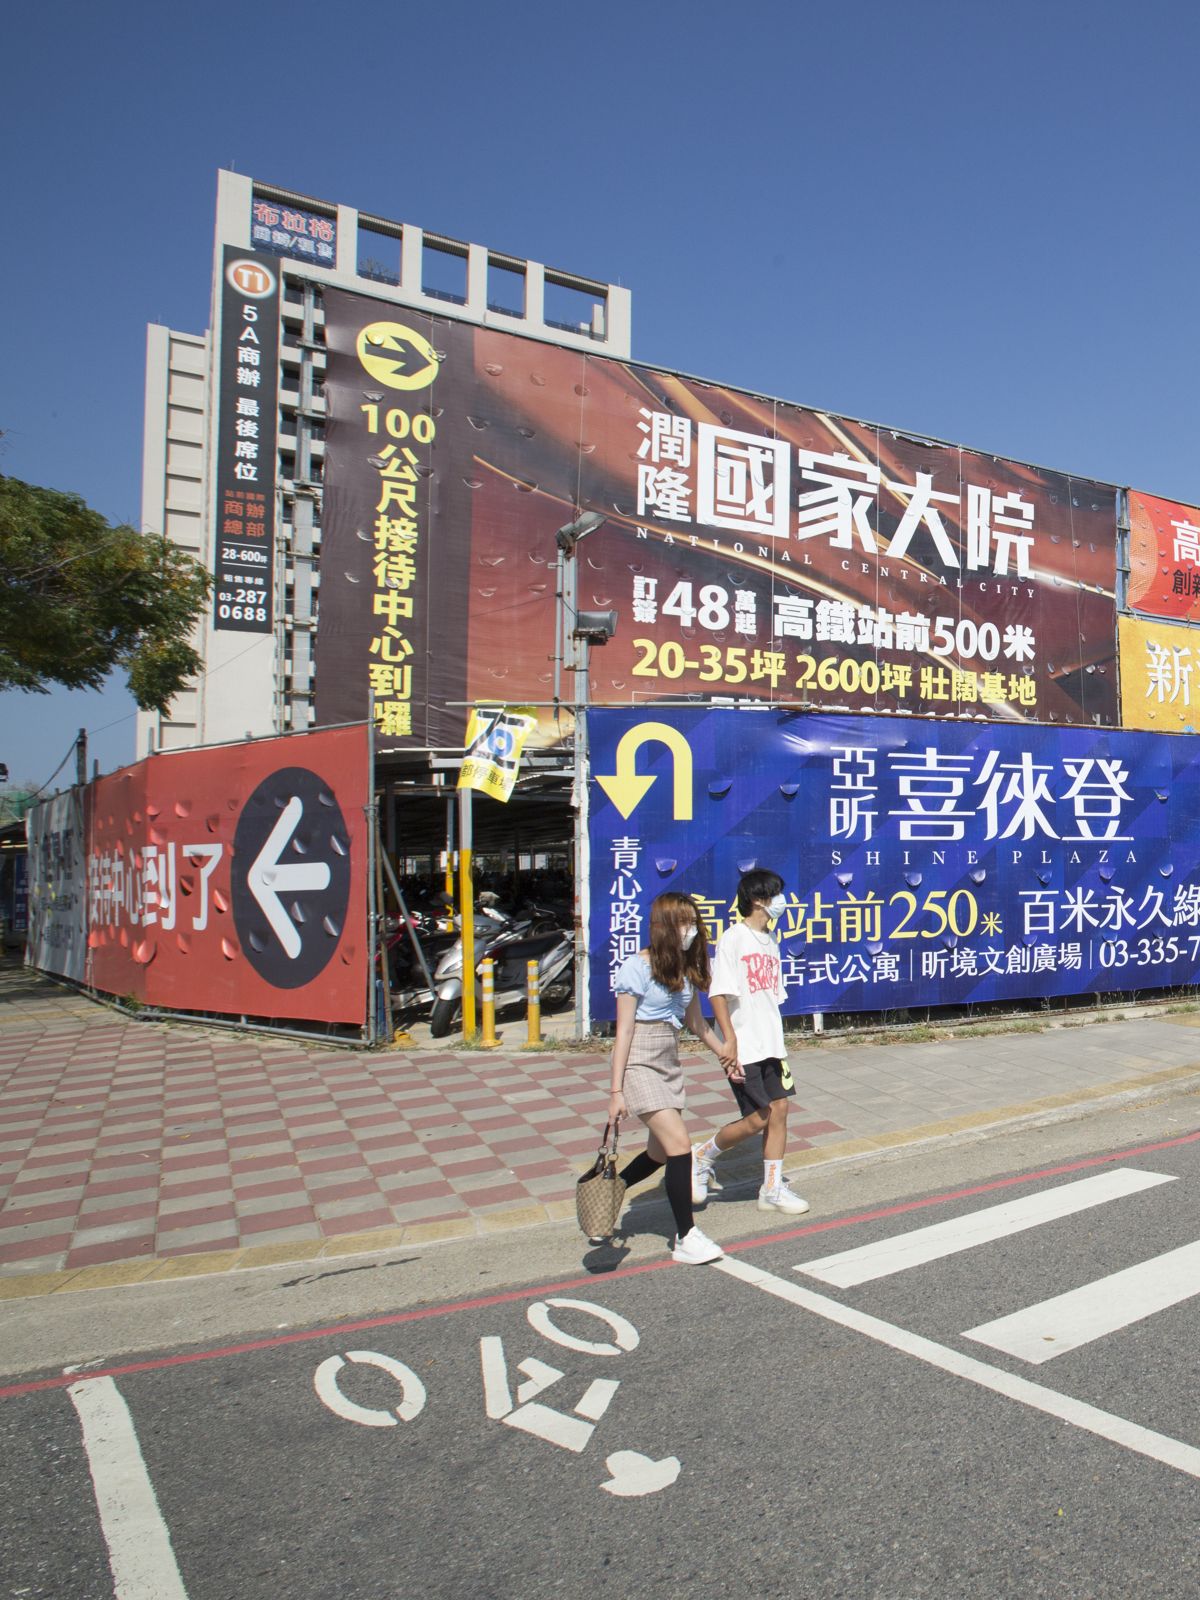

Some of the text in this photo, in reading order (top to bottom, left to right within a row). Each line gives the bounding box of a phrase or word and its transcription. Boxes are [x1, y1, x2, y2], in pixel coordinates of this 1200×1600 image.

[234, 397, 260, 482] 最後席位
[635, 408, 692, 523] 潤隆
[223, 501, 266, 519] 商辦
[223, 519, 266, 537] 總部
[697, 421, 1036, 579] 國家大院
[219, 588, 268, 605] 03-287
[636, 526, 1036, 598] NATIONAL CENTRAL CITY
[219, 605, 267, 622] 0688
[662, 581, 730, 631] 48
[773, 595, 1036, 663] 高鐵站前500米
[632, 638, 1037, 706] 20-35坪 2600坪 壯闊基地
[830, 746, 878, 842] 亞昕
[888, 747, 1135, 842] 喜徠登
[831, 850, 1137, 865] SHINE PLAZA
[921, 942, 1081, 980] 昕境文創廣場
